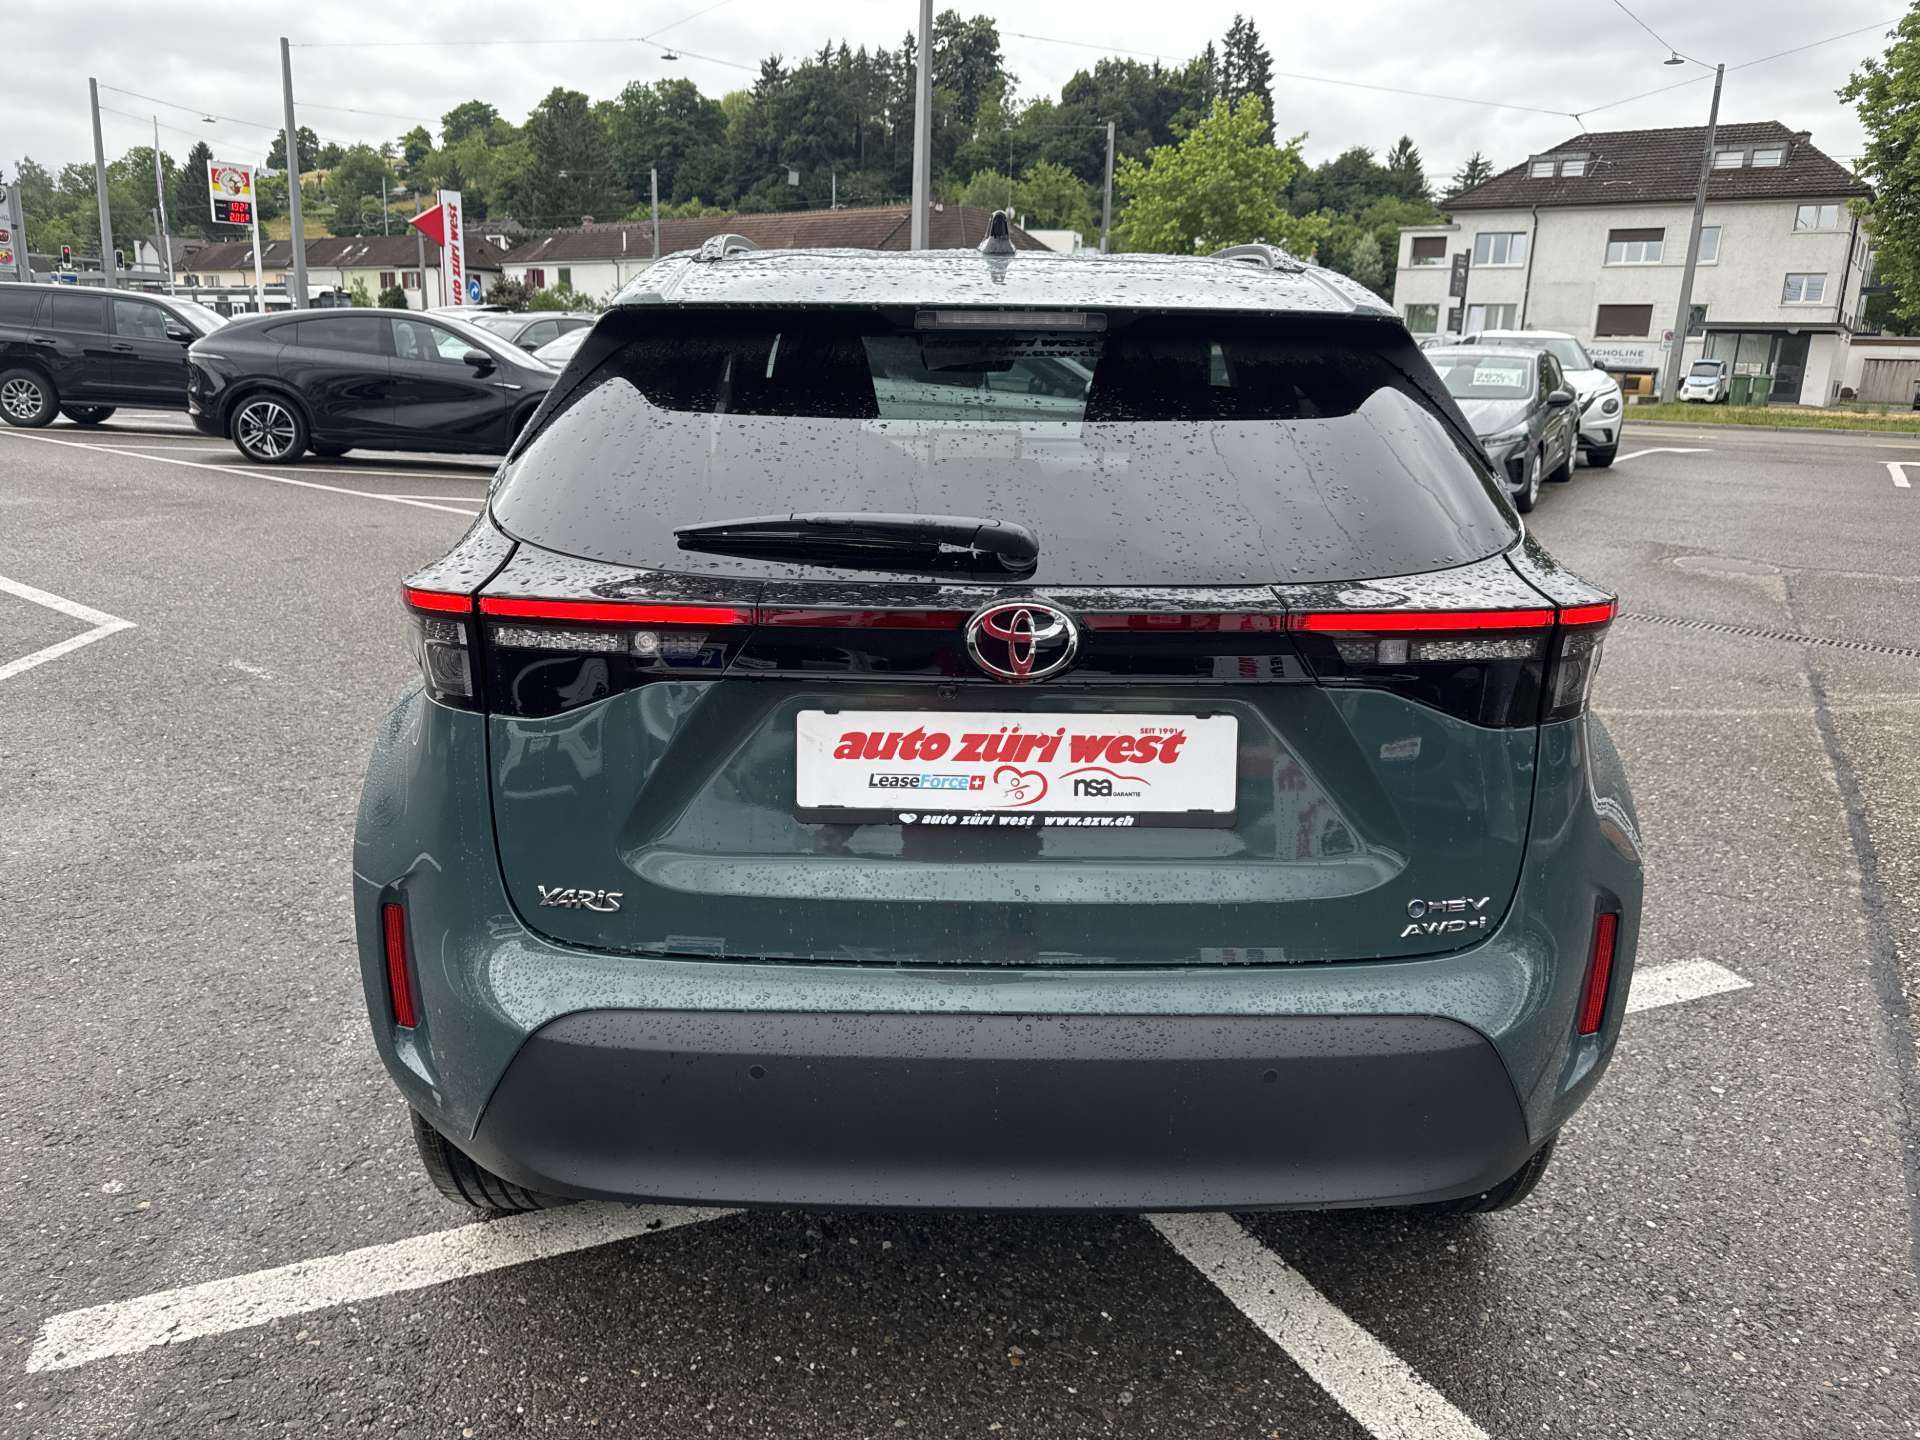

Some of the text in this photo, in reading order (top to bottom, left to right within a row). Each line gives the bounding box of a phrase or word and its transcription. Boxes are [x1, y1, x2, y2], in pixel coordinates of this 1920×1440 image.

[447, 202, 459, 241] west
[453, 279, 463, 306] uto
[1140, 727, 1179, 735] SEIT 1991
[833, 725, 1188, 764] auto züri west
[869, 773, 969, 790] LeaseForce
[1073, 778, 1113, 797] nsa
[921, 813, 1135, 827] auto züri west www.azw.ch
[1426, 897, 1490, 913] HEV
